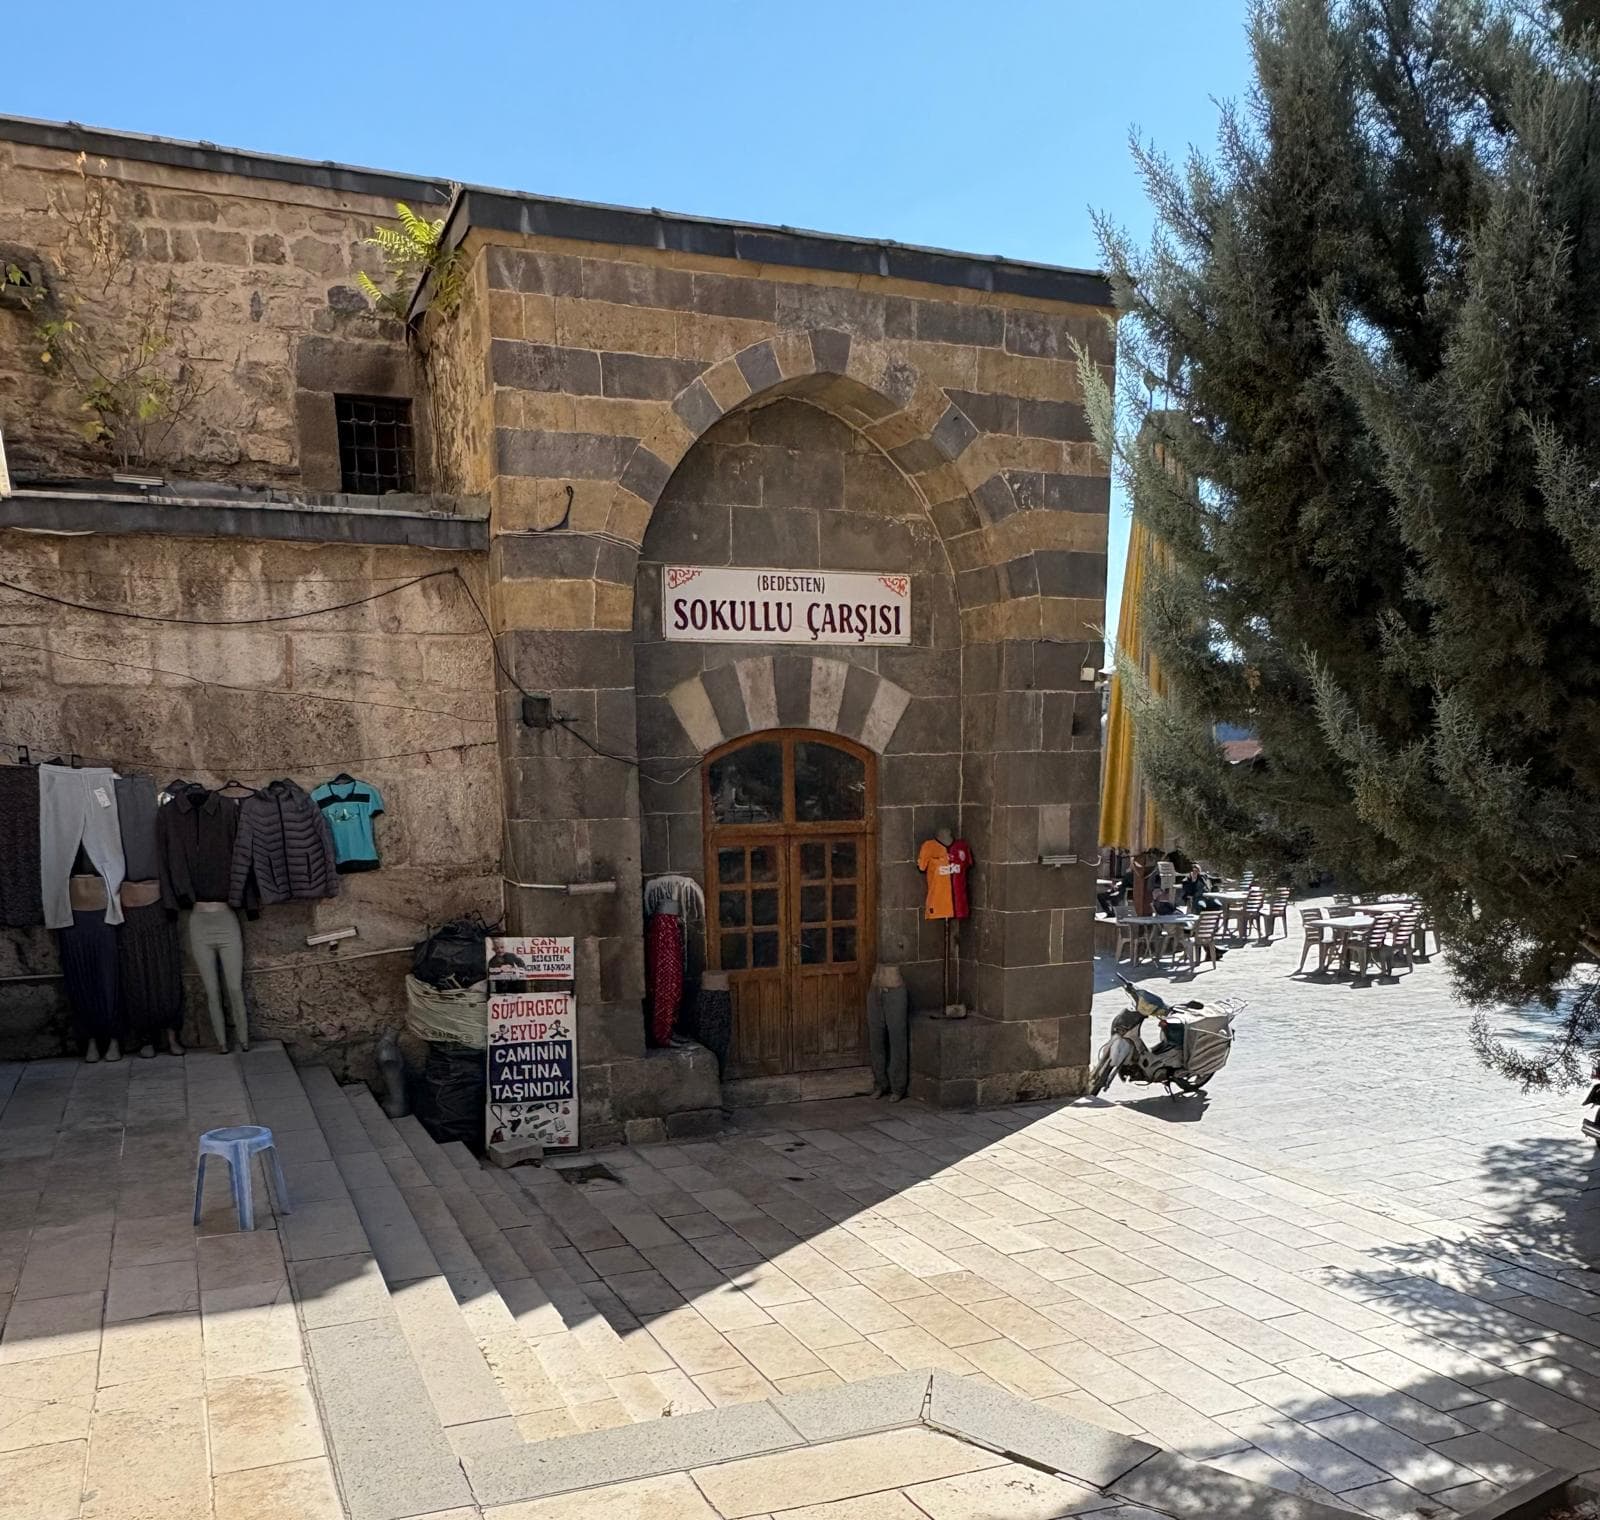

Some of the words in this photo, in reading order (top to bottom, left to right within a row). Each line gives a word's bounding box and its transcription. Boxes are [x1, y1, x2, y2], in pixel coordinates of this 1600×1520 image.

[757, 575, 825, 594] (BEDESTEN)
[673, 598, 793, 632] SOKULLU
[806, 602, 901, 642] ÇARŞISI
[491, 995, 568, 1020] SÜPÜRGECİ
[510, 1019, 547, 1041] EYÜP
[495, 1041, 567, 1063] CAMİNİN
[500, 1062, 562, 1081] ALTINA
[492, 1080, 570, 1102] TAŞINDIK
